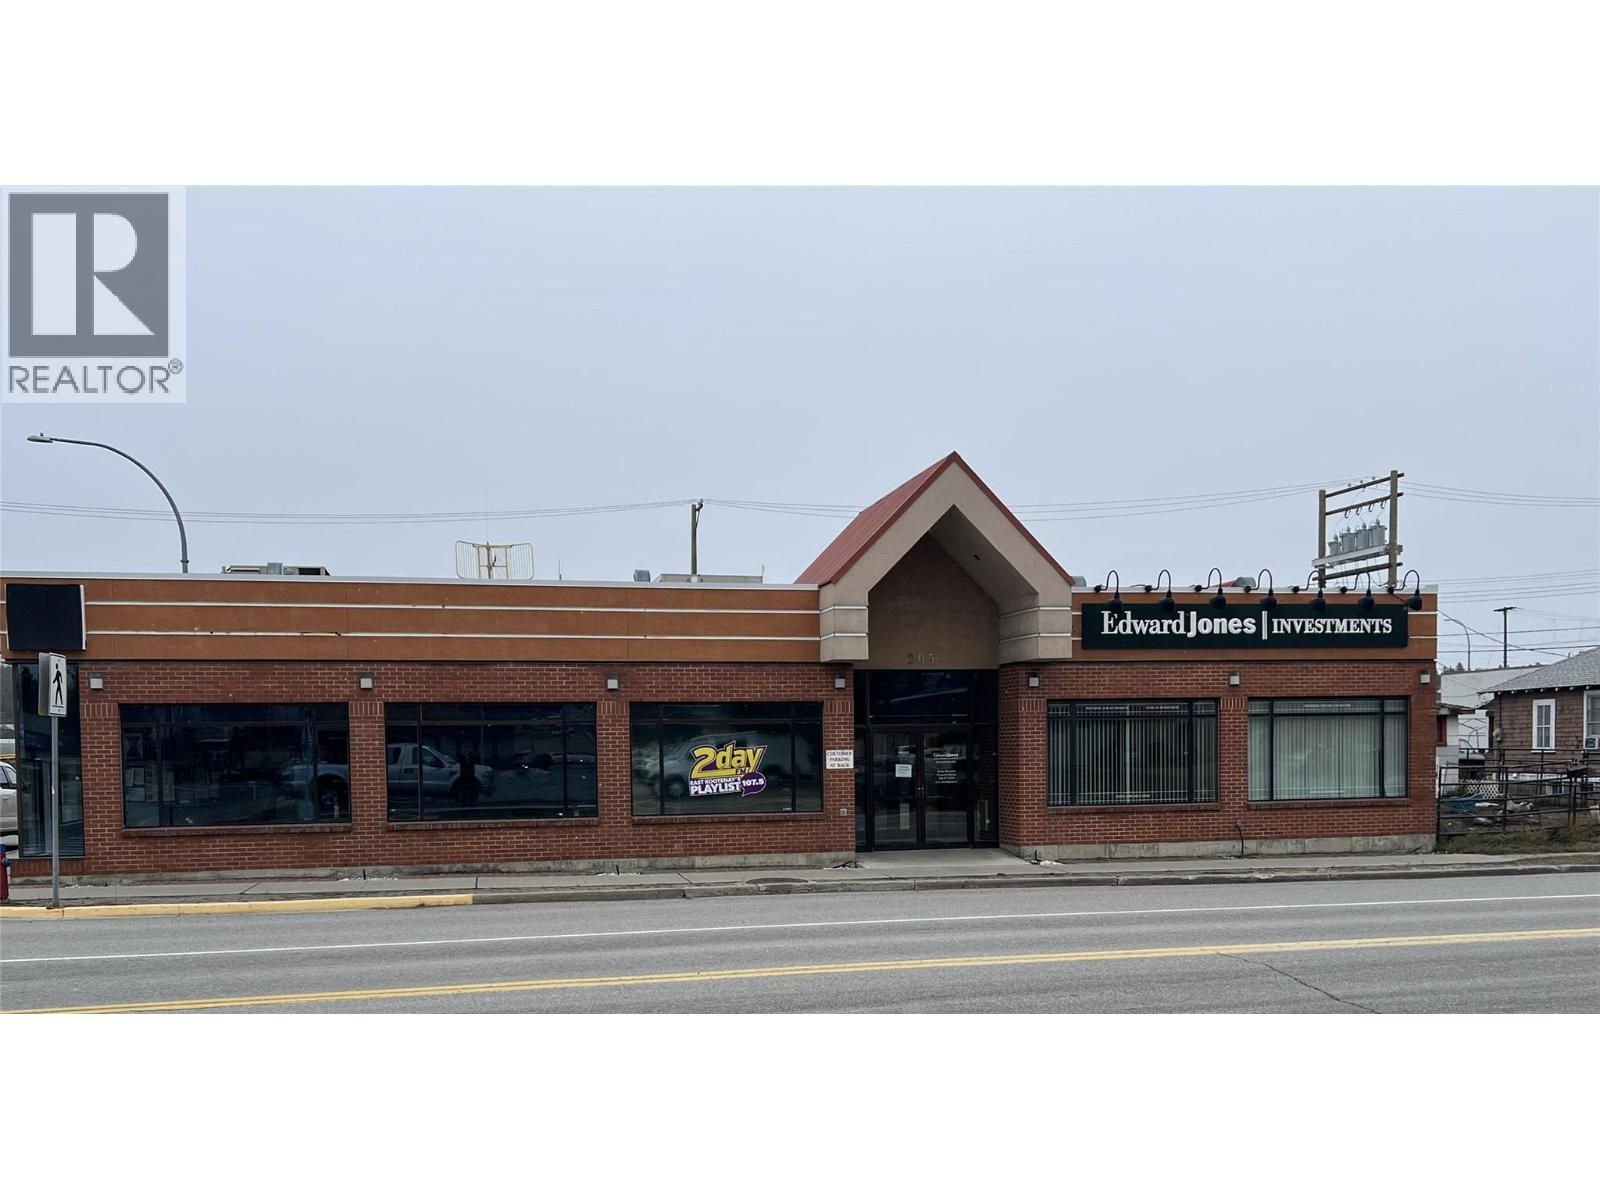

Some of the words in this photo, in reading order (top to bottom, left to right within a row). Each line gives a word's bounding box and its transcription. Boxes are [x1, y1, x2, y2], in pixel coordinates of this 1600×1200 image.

[1271, 617, 1393, 635] INVESTMENTS
[690, 744, 765, 779] 2day
[690, 782, 741, 795] PLAYLIST
[741, 778, 765, 787] 107.5
